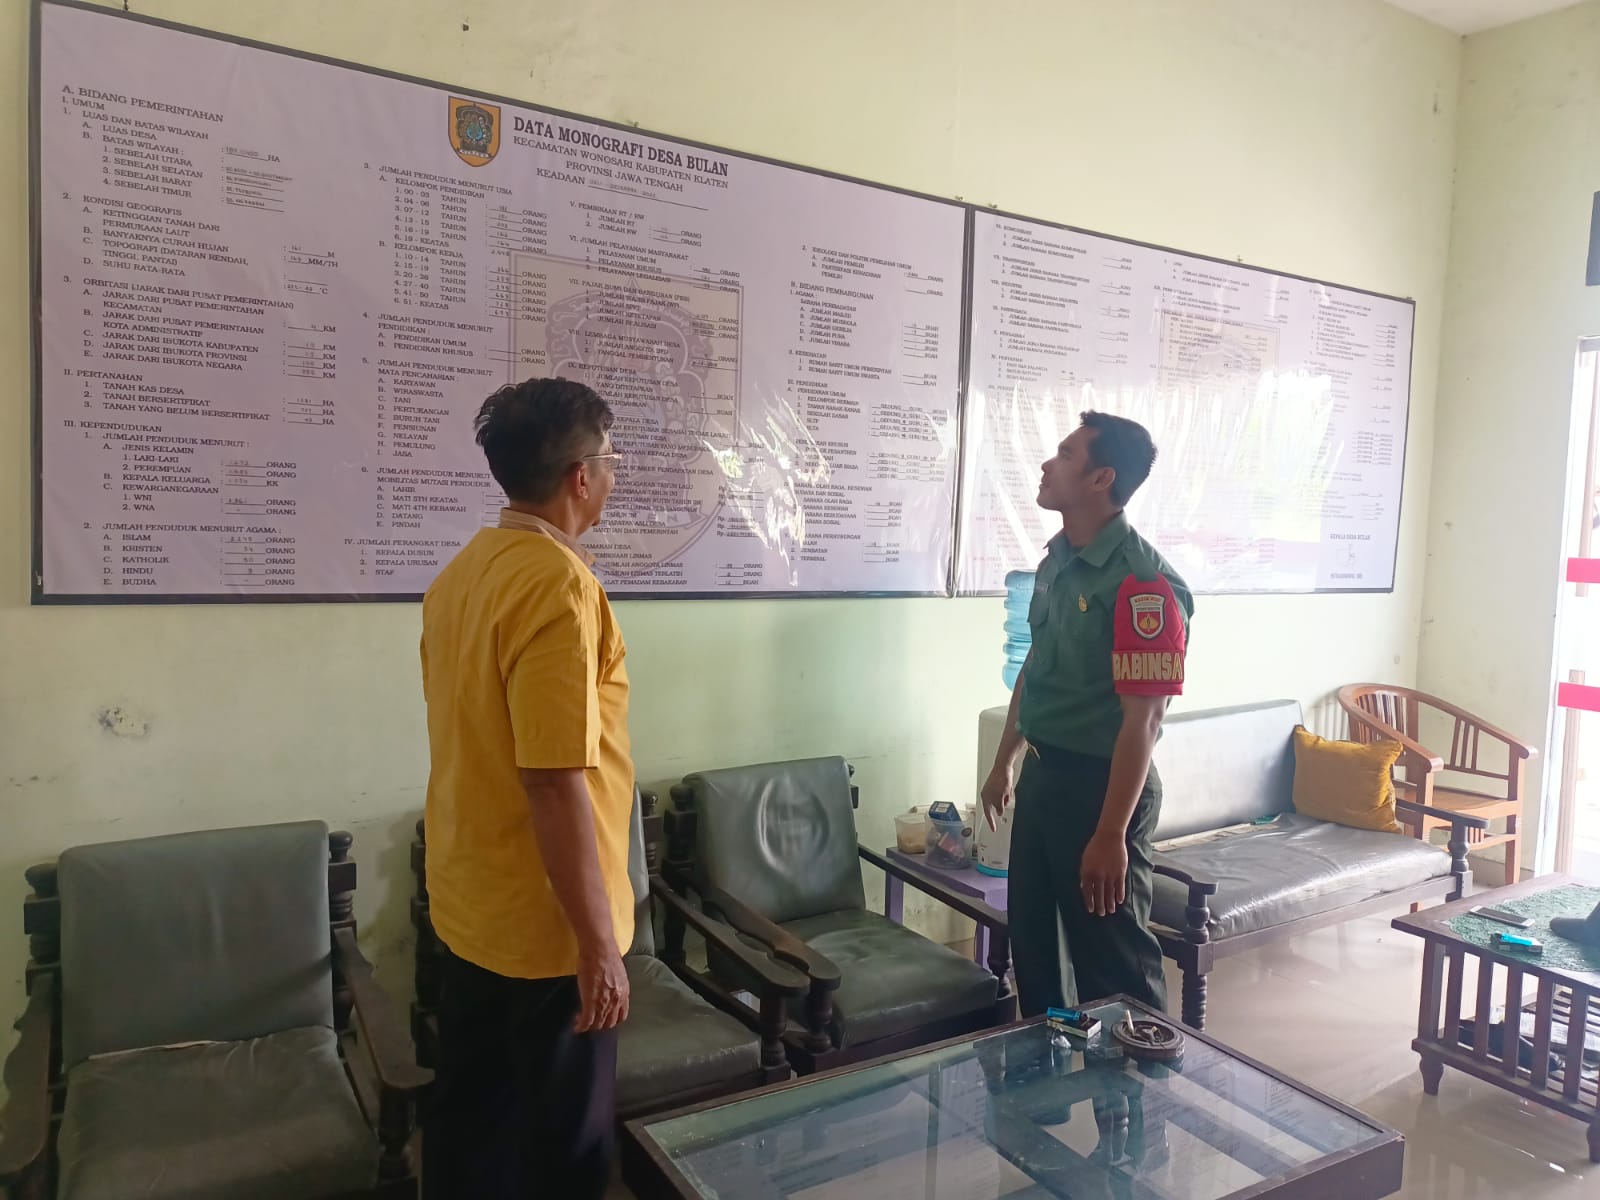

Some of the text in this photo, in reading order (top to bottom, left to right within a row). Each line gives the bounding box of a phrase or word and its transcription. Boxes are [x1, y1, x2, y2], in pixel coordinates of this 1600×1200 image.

[62, 85, 223, 122] A. BIDANG PEMERINTAHAN
[72, 98, 104, 110] UMUM
[83, 110, 208, 140] LUAS DAN BATAS WILAYAH
[103, 125, 157, 140] LUAS DESA
[103, 136, 178, 154] BATAS WILAYAH
[514, 117, 728, 177] DATA MONOGRAFI DESA BULAN
[114, 147, 192, 167] SEBELAH UTARA
[268, 154, 280, 162] HA
[514, 136, 728, 189] KECAMATAN WONOSARI KABUPATEN KLATEN
[114, 157, 202, 178] SEBELAH SELATAN
[114, 168, 192, 187] SEBELAH BARAT
[379, 166, 412, 177] JUMLAH
[414, 172, 456, 185] PENDUDUK
[458, 180, 494, 192] MENURUT
[536, 168, 585, 184] KEADAAN
[566, 161, 612, 177] PROVINSI
[615, 172, 642, 184] JAWA
[644, 177, 683, 192] TENGAH
[114, 179, 192, 198] SEBELAH TIMUR
[395, 178, 484, 198] KELOMPOK PENDIDIKAN
[83, 195, 182, 216] KONDISI GEOGRAFIS
[441, 195, 466, 204] TAHUN
[103, 209, 220, 232] KETINGGIAN TANAH DARI
[522, 210, 547, 219] ORANG
[103, 219, 190, 237] PERMUKAAN LAUT
[103, 229, 228, 252] BANYAKNYA CURAH HUJAN
[103, 260, 185, 276] SUHU RATA-RATA
[103, 291, 264, 315] JARAK DARI PUSAT PEMERINTAHAN
[104, 301, 162, 313] KECAMATAN
[104, 321, 202, 337] KOTA ADMINISTRATIF
[378, 323, 426, 334] PENDIDIKAN
[394, 333, 467, 347] PENDIDIKAN UMUM
[394, 343, 473, 357] PENDIDIKAN KHUSUS
[103, 352, 242, 371] JARAK DARI IBUKOTA NEGARA
[77, 370, 142, 381] PERTANAHAN
[378, 368, 399, 377] MATA
[103, 382, 184, 395] TANAH KAS DESA
[393, 379, 435, 388] KARYAWAN
[103, 392, 210, 406] TANAH BERSERTIFIKAT
[393, 387, 443, 398] WIRASWASTA
[103, 402, 270, 421] TANAH YANG BELUM BERSERTIFIKAT
[393, 406, 449, 415] PERTUKANGAN
[393, 415, 421, 423] BURUH
[80, 421, 162, 432] KEPENDUDUKAN
[393, 424, 436, 432] PENSIUNAN
[103, 433, 245, 447] JUMLAH PENDUDUK MENURUT
[393, 432, 428, 441] NELAYAN
[122, 444, 194, 454] JENIS KELAMIN
[393, 441, 436, 450] PEMULUNG
[134, 455, 179, 463] LAKI-LAKI
[267, 461, 296, 469] ORANG
[134, 464, 191, 473] PEREMPUAN
[123, 474, 210, 484] KEPALA KELUARGA
[123, 484, 219, 494] KEWARGANEGARAAN
[103, 523, 276, 534] JUMLAH PENDUDUK MENURUT AGAMA
[122, 556, 169, 564] KATHOLIK
[122, 567, 153, 575] HINDU
[1112, 653, 1183, 680] BABINSA
